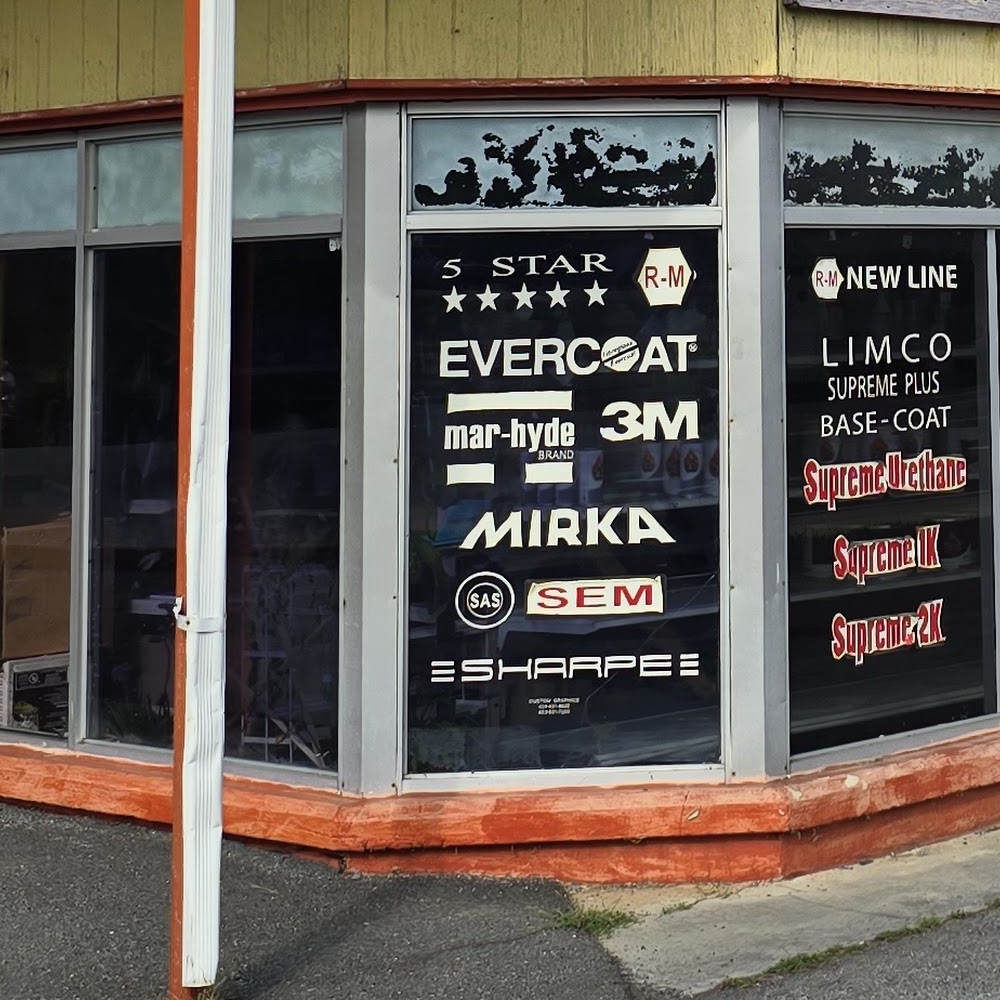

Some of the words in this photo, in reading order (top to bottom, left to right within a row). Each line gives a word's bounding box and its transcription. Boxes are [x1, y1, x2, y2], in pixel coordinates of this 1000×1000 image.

[442, 259, 461, 279] 5
[492, 253, 613, 277] STAR
[846, 265, 901, 290] NEW
[908, 264, 958, 289] LINE
[822, 332, 952, 367] LIMCO
[827, 373, 898, 401] SUPREME
[905, 370, 940, 395] PLUS
[444, 417, 576, 452] mar-hyde
[600, 401, 700, 441] 3M
[538, 450, 574, 460] BRAND
[803, 458, 887, 511] Supreme
[886, 449, 967, 492] Urethane
[459, 507, 677, 550] MIRKA
[833, 534, 916, 586] Supreme
[469, 592, 501, 608] SAS
[537, 584, 653, 609] SEM
[831, 612, 917, 666] Supreme
[916, 598, 945, 648] 2K
[461, 655, 673, 682] SHARPE
